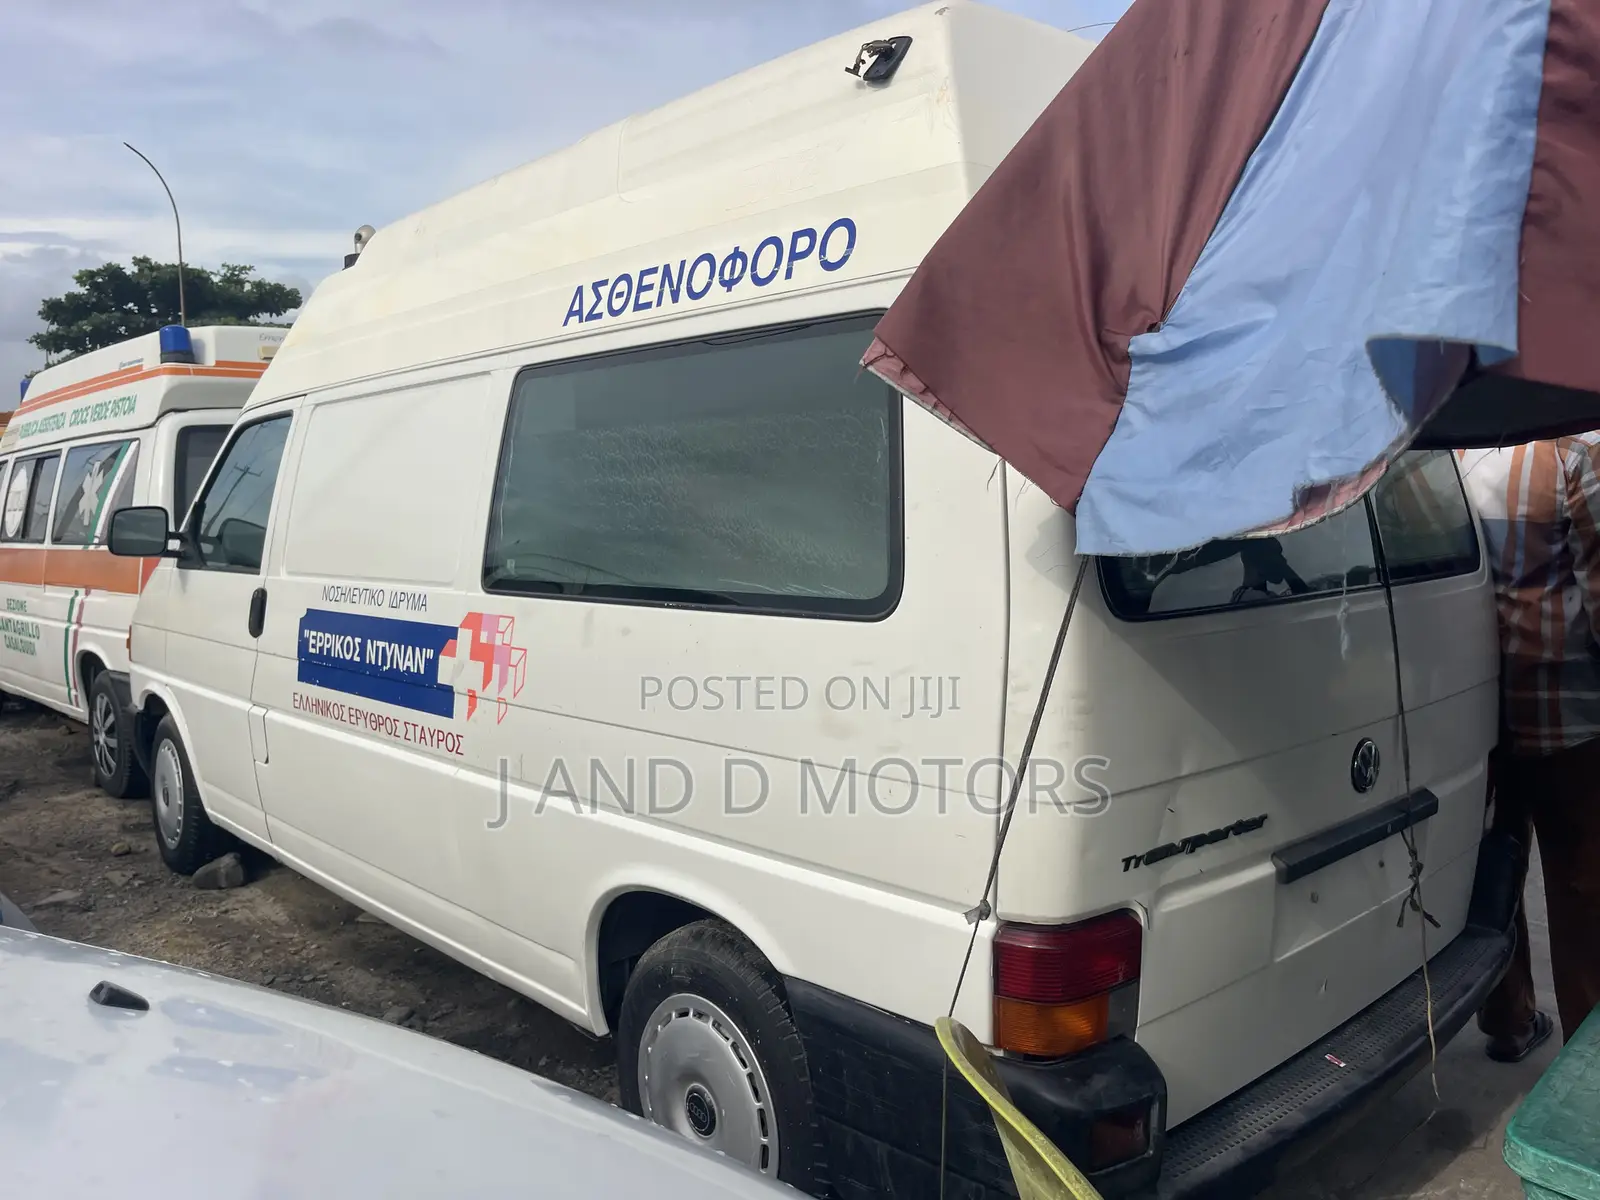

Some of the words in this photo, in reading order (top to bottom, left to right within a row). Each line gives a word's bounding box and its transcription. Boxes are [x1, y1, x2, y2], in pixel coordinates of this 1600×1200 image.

[563, 217, 857, 327] ΑΣΘΕΝΟΦΟΡΟ
[69, 404, 91, 427] CROCE
[90, 400, 112, 422] VERDE
[109, 393, 138, 419] PISTOIA
[6, 597, 27, 613] SEZIONE
[321, 585, 385, 608] ΝΟΣΗΛΕΥΤΙΚΟ
[388, 589, 428, 612] ΙΔΡΥΜΑ
[304, 629, 362, 662] "ΕΡΡΙΚΟΣ
[292, 692, 347, 723] ΕΛΛΗΝΙΚΟΣ
[348, 706, 400, 739] ΕΡΥΘΡΟΣ
[403, 722, 464, 756] ΣΤΑΥΡΟΣ
